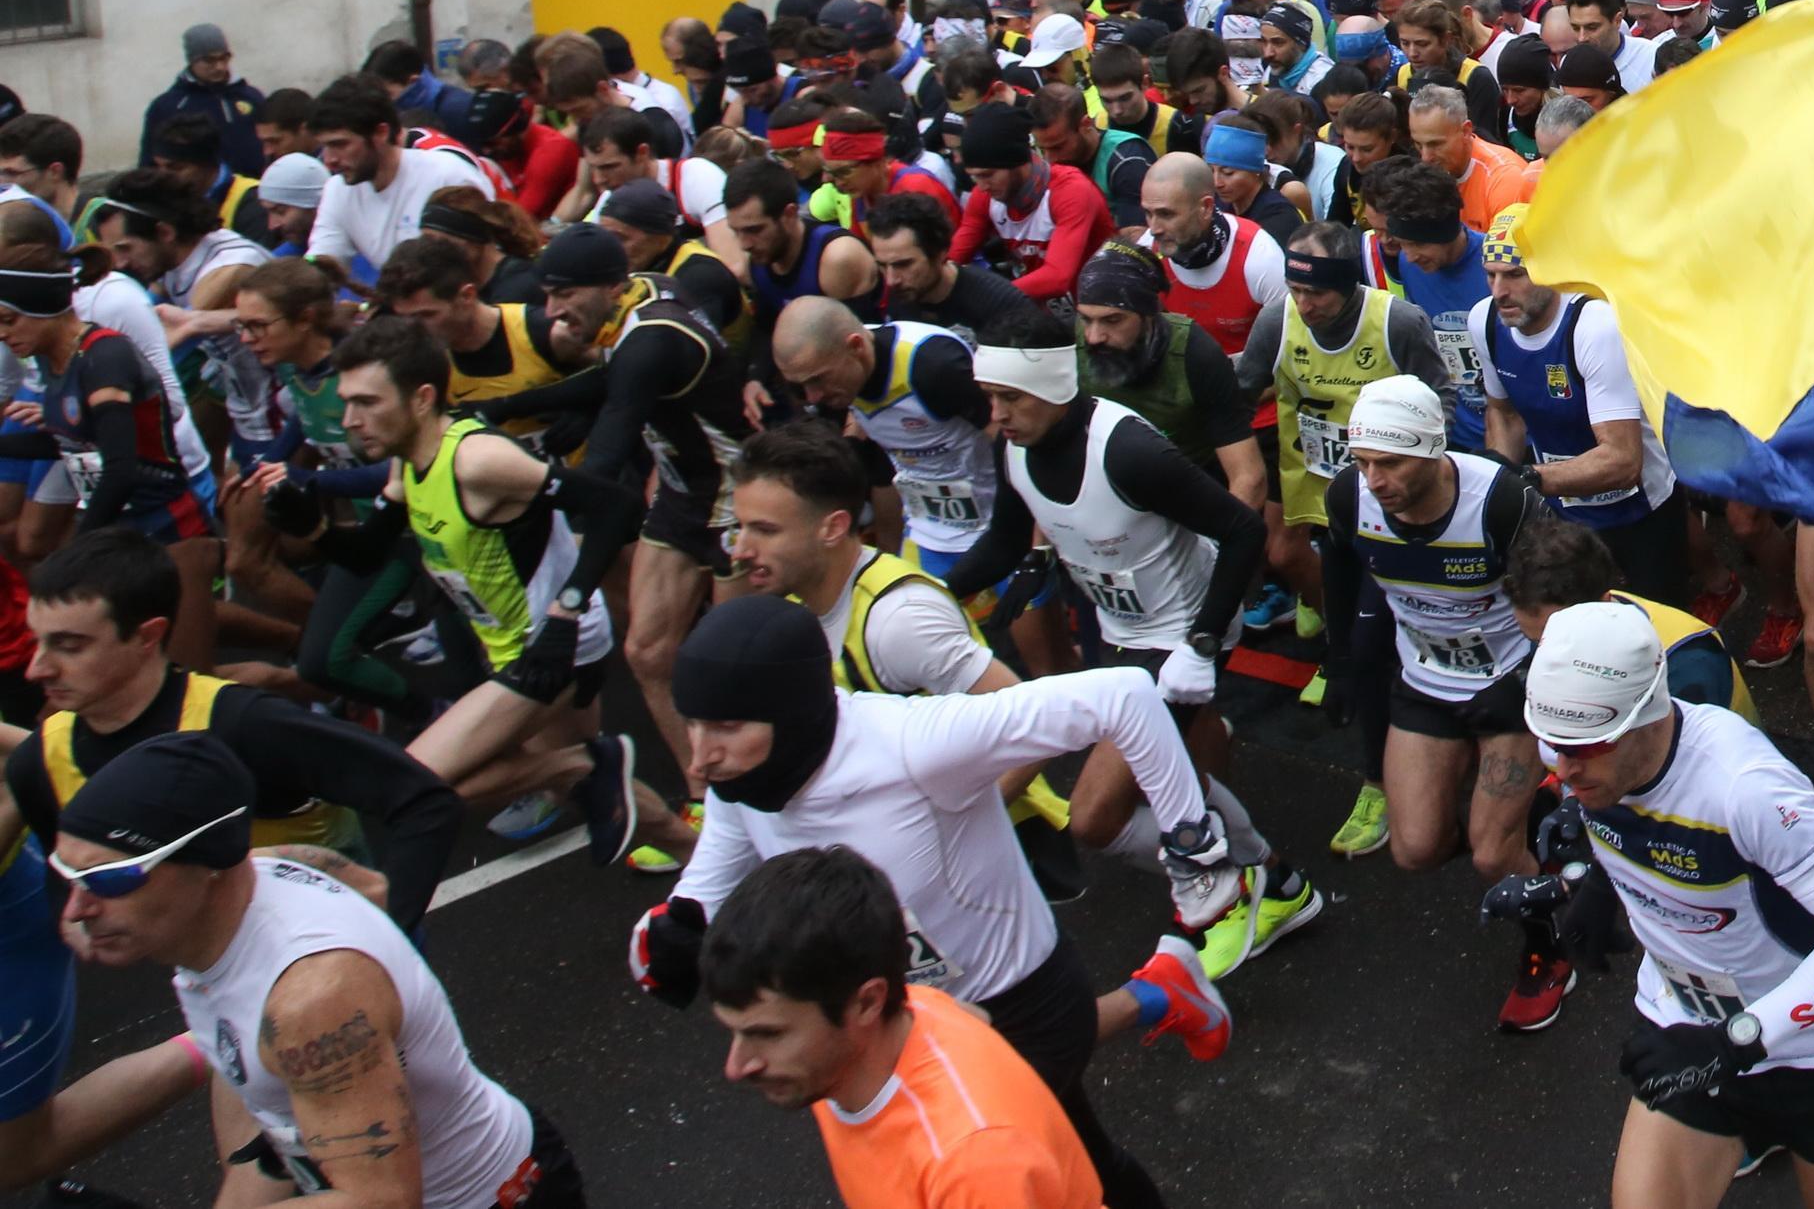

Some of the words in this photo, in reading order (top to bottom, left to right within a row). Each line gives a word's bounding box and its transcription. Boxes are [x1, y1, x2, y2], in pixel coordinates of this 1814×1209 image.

[1298, 374, 1311, 384] La
[931, 498, 966, 520] 70
[1445, 563, 1487, 574] MdS
[1650, 849, 1699, 871] MdS
